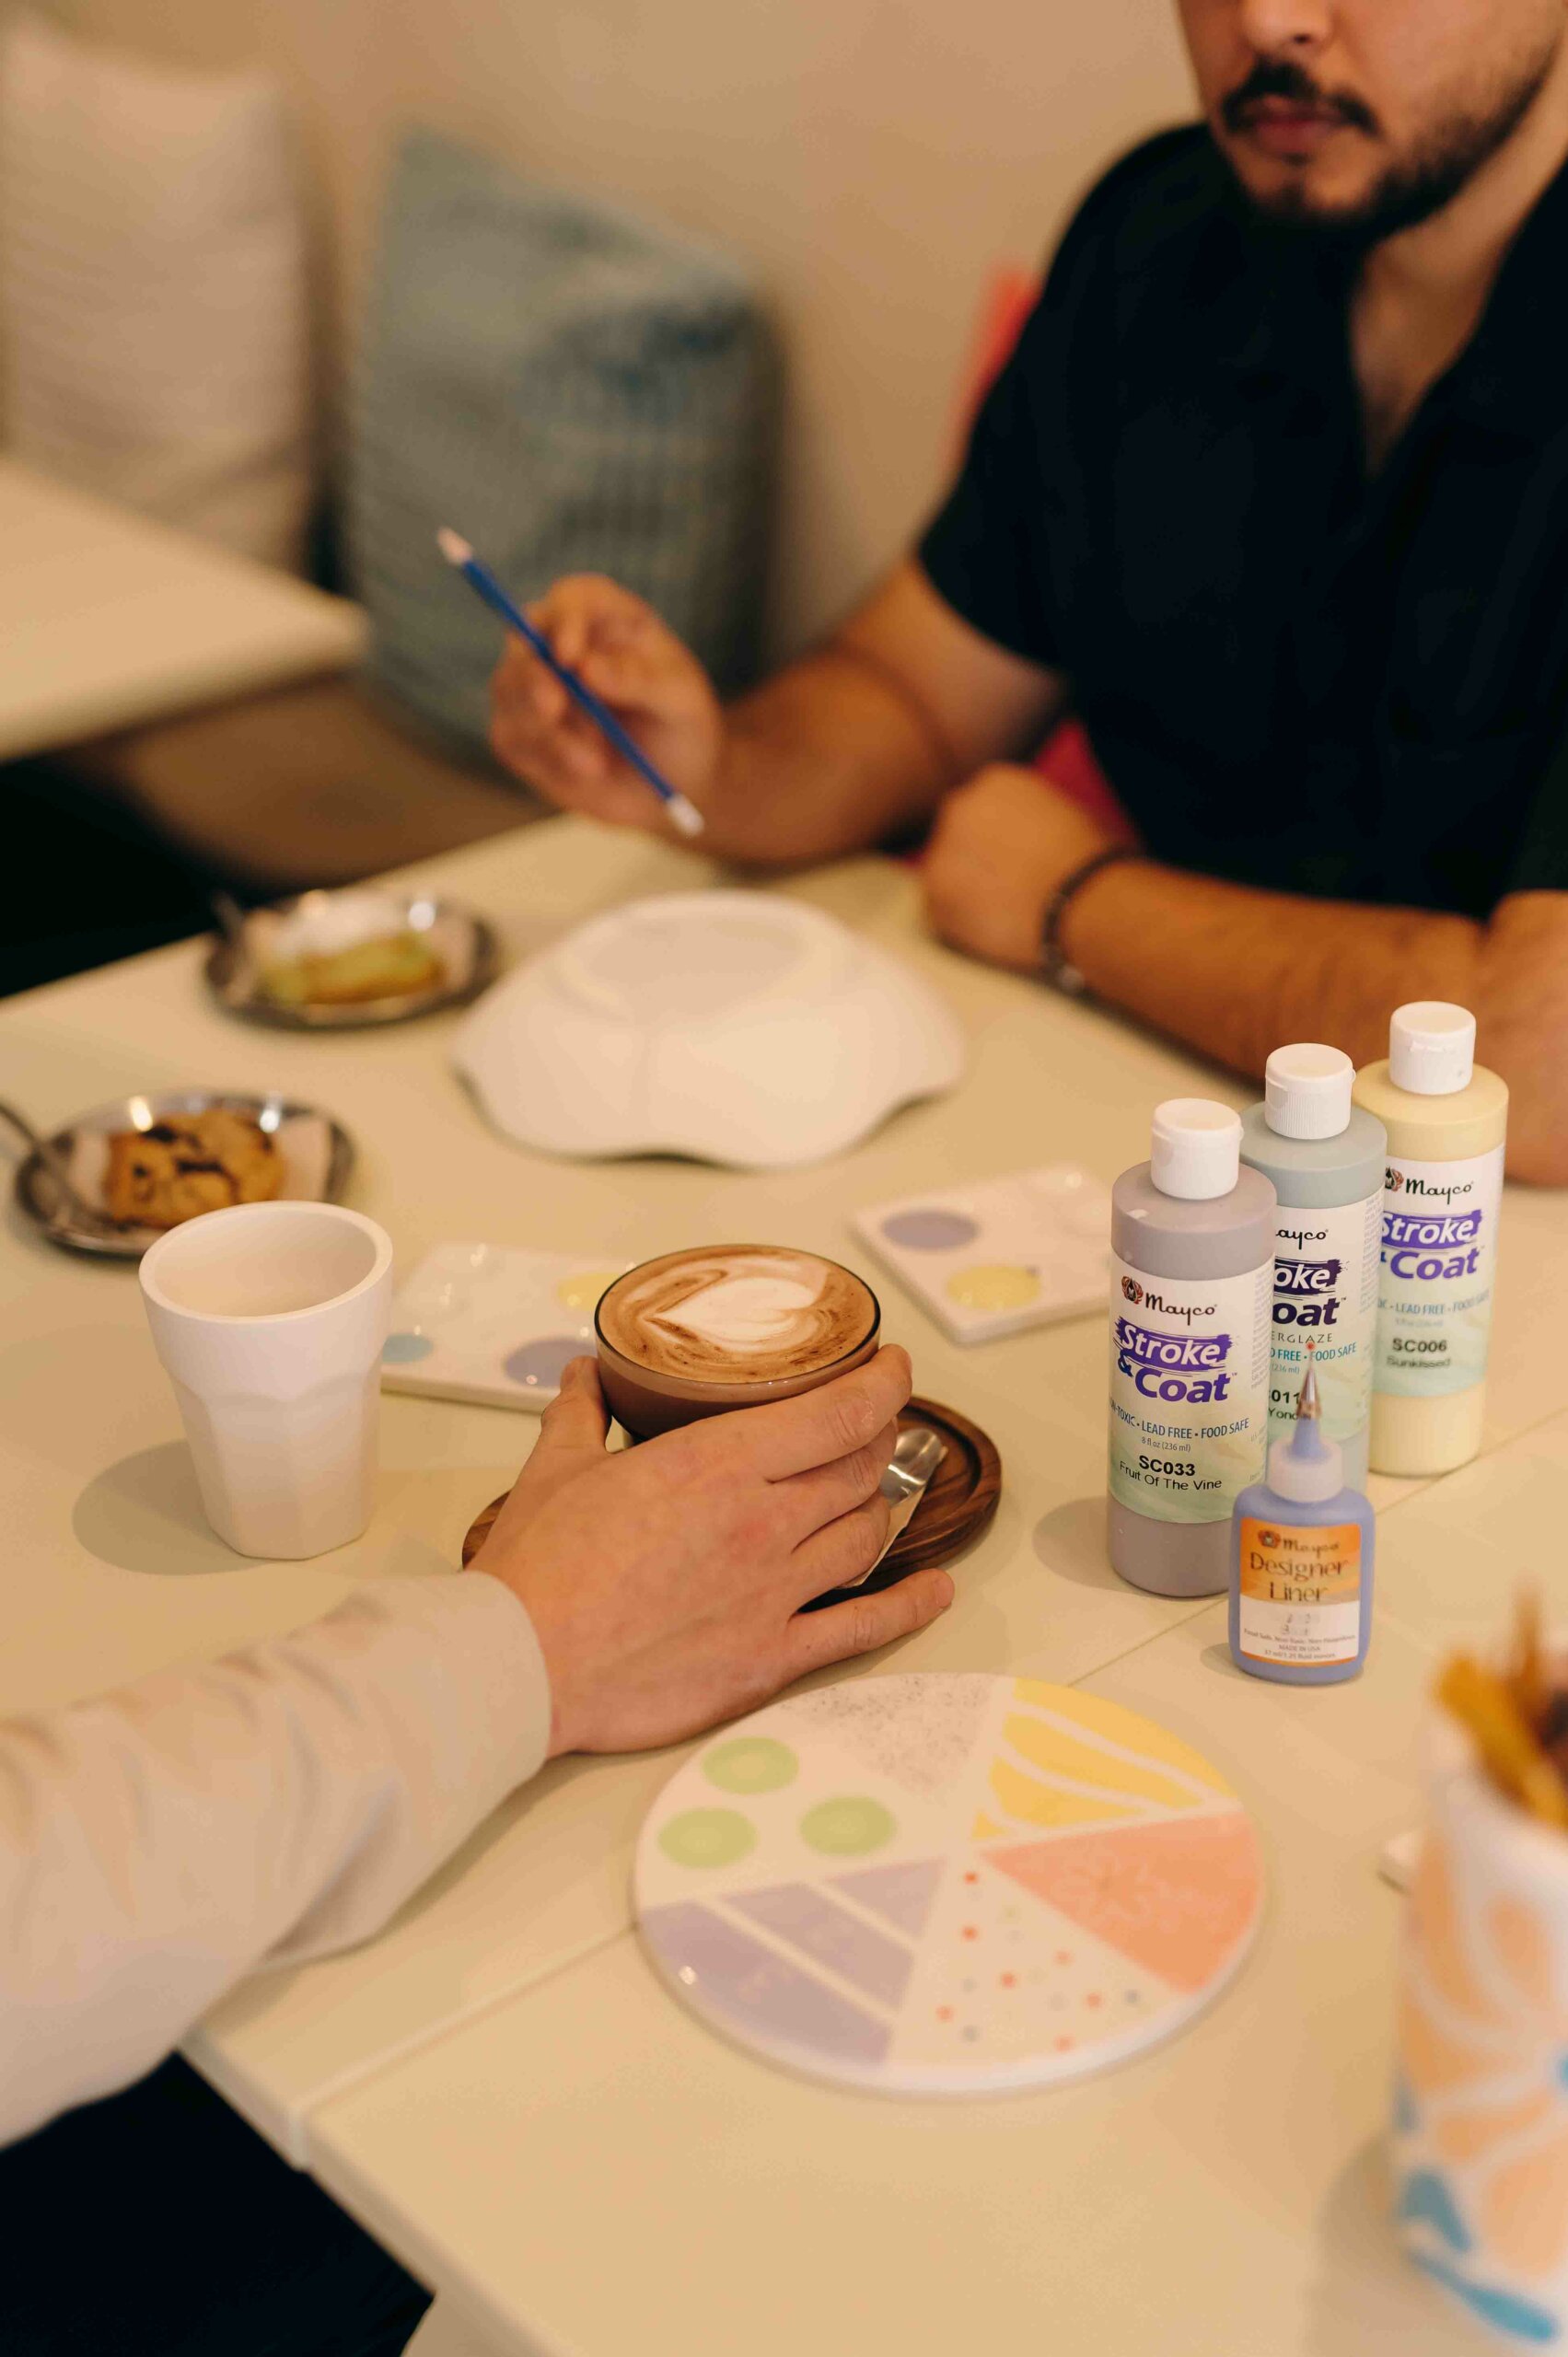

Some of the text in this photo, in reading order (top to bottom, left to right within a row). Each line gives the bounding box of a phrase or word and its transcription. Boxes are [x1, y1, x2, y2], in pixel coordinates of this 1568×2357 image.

[1405, 1178, 1472, 1205] Mayco
[1275, 1229, 1327, 1250] ayco
[1381, 1214, 1474, 1245] Stroke
[1273, 1263, 1331, 1290] oke
[1390, 1248, 1481, 1281] Coat
[1145, 1293, 1215, 1326] Mayco
[1272, 1297, 1341, 1327] oat
[1121, 1324, 1221, 1365] Stroke
[1271, 1330, 1333, 1344] ERGLAZE
[1392, 1338, 1447, 1353] SC006
[1277, 1349, 1302, 1362] FREE
[1338, 1341, 1357, 1358] SAFE
[1134, 1367, 1231, 1404] Coat
[1271, 1388, 1302, 1404] 011
[1142, 1420, 1166, 1436] LEAD
[1167, 1427, 1192, 1439] FREE
[1201, 1426, 1227, 1439] FOOD
[1229, 1418, 1249, 1434] SAFE
[1120, 1460, 1223, 1491] Fruit Of The Vine
[1138, 1455, 1196, 1477] SC033
[1249, 1551, 1350, 1583] Designer
[1269, 1581, 1329, 1602] Liner
